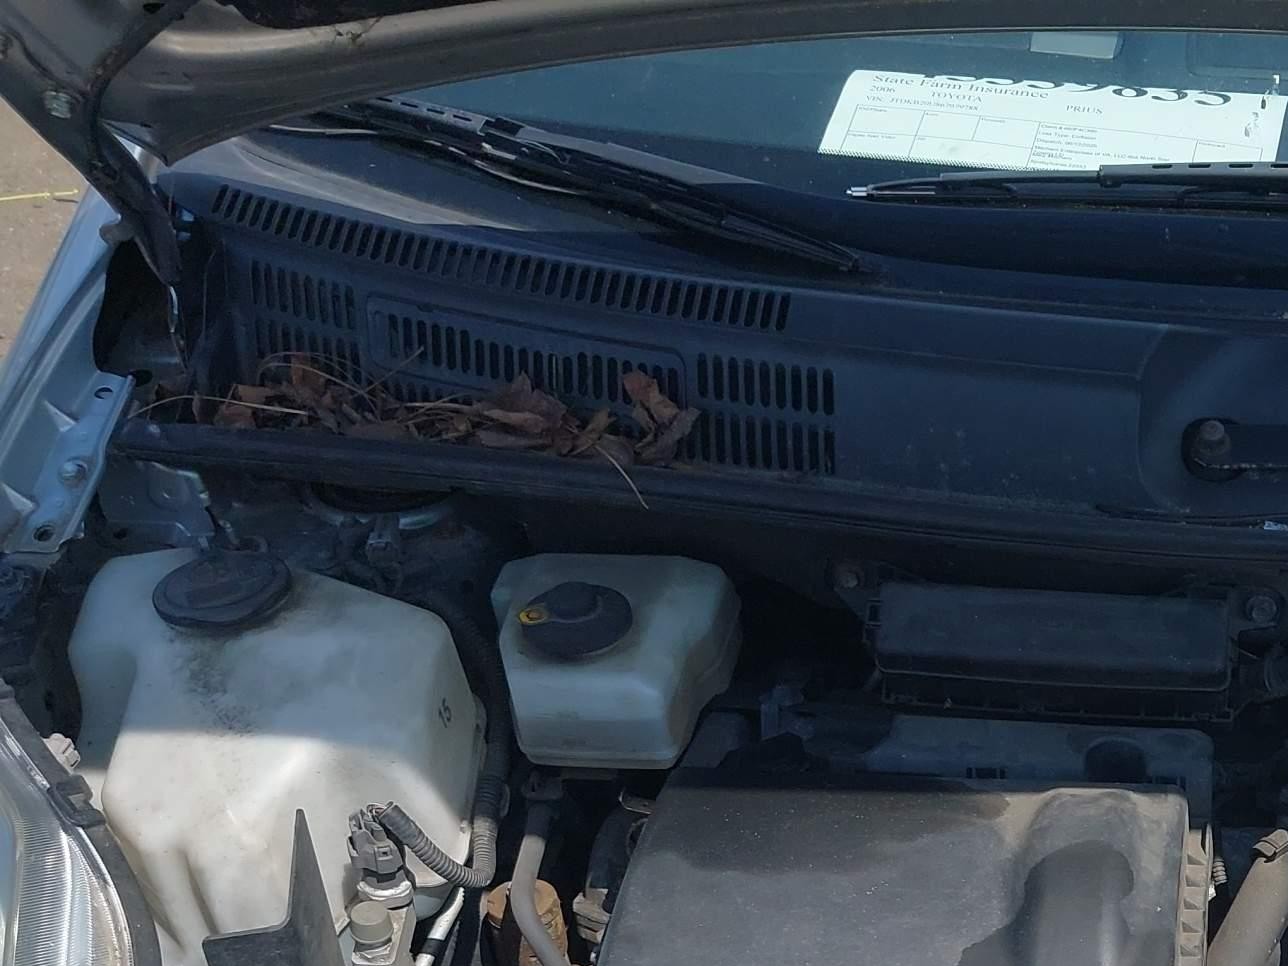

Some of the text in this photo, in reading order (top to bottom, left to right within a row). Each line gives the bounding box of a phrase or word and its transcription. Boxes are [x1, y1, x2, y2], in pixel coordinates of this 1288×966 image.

[870, 85, 896, 94] 2006
[872, 75, 915, 85] State
[920, 79, 967, 91] Farm
[968, 83, 1049, 99] Insurance
[931, 91, 983, 103] TOYOTA
[1066, 104, 1104, 115] PRIUS
[439, 697, 452, 729] 15
